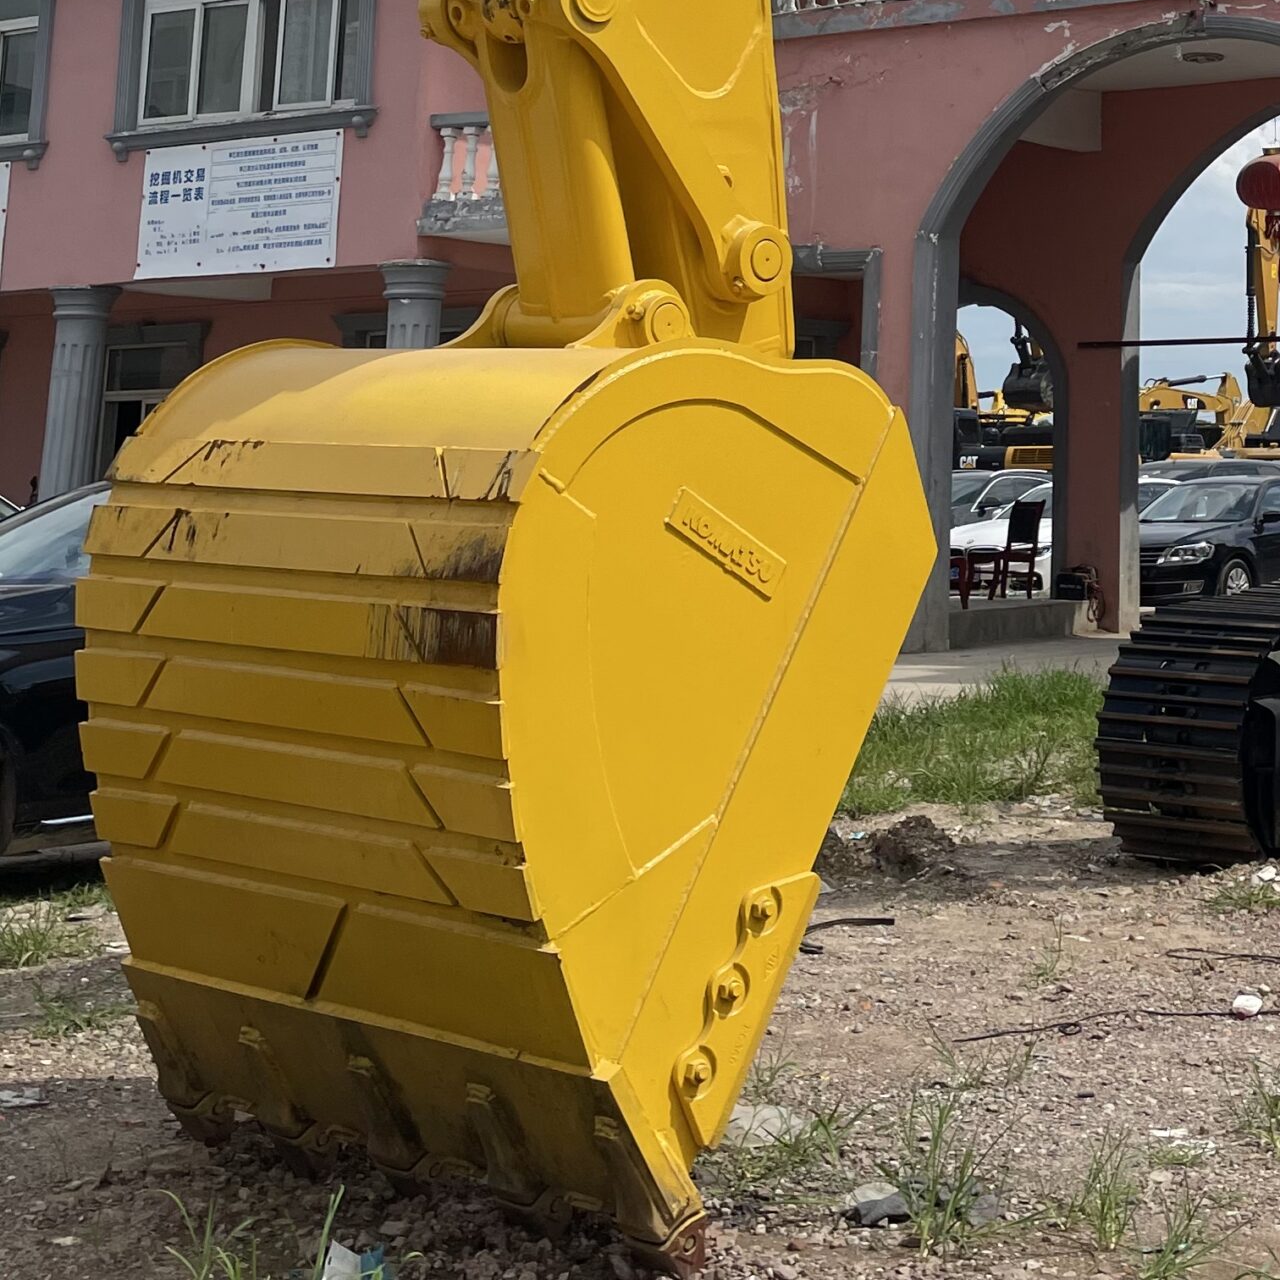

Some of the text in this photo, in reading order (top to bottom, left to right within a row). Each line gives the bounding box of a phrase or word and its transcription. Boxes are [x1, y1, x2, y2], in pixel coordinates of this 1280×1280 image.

[149, 167, 206, 188] 挖掘机交易
[148, 186, 205, 205] 流程一览表
[960, 455, 979, 469] CAT
